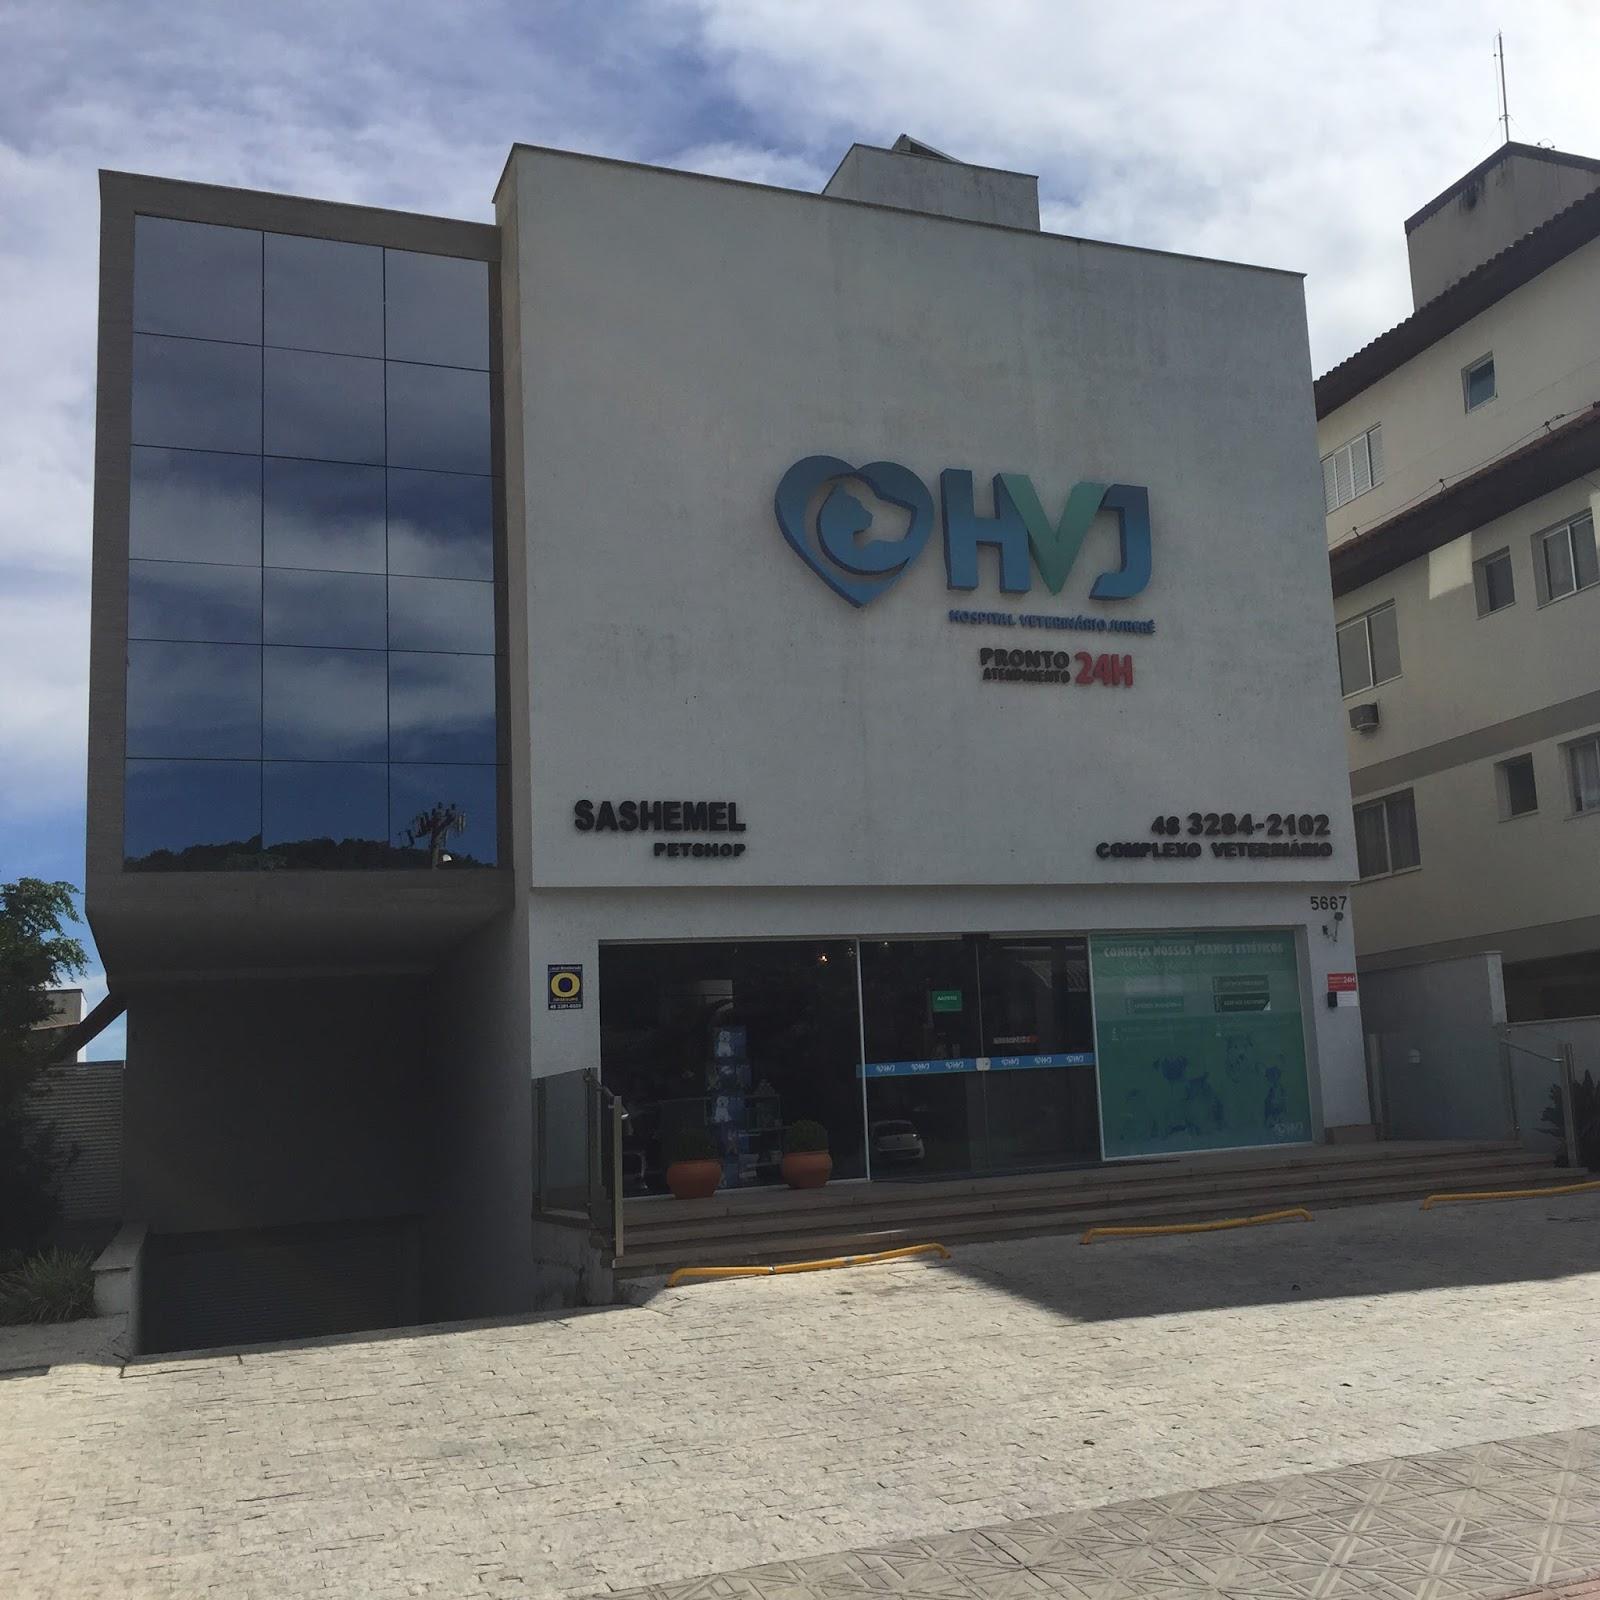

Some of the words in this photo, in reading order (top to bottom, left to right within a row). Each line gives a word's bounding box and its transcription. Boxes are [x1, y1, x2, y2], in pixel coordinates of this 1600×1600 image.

[940, 468, 1152, 600] HVJ
[948, 609, 1015, 626] HOSPITAL
[1019, 613, 1106, 632] VETERINÁRIO
[980, 647, 1070, 669] PRONTO
[982, 667, 1071, 684] ATENDIMENTO
[1075, 652, 1134, 687] 24H
[574, 800, 746, 831] SASHEMEL
[1151, 815, 1180, 836] 48
[1187, 812, 1331, 836] 3284-2102
[653, 843, 746, 857] PETSHOP
[1096, 842, 1202, 858] COMPLEXO
[1211, 839, 1333, 858] VETERINÁRIO
[1310, 895, 1347, 911] 5667
